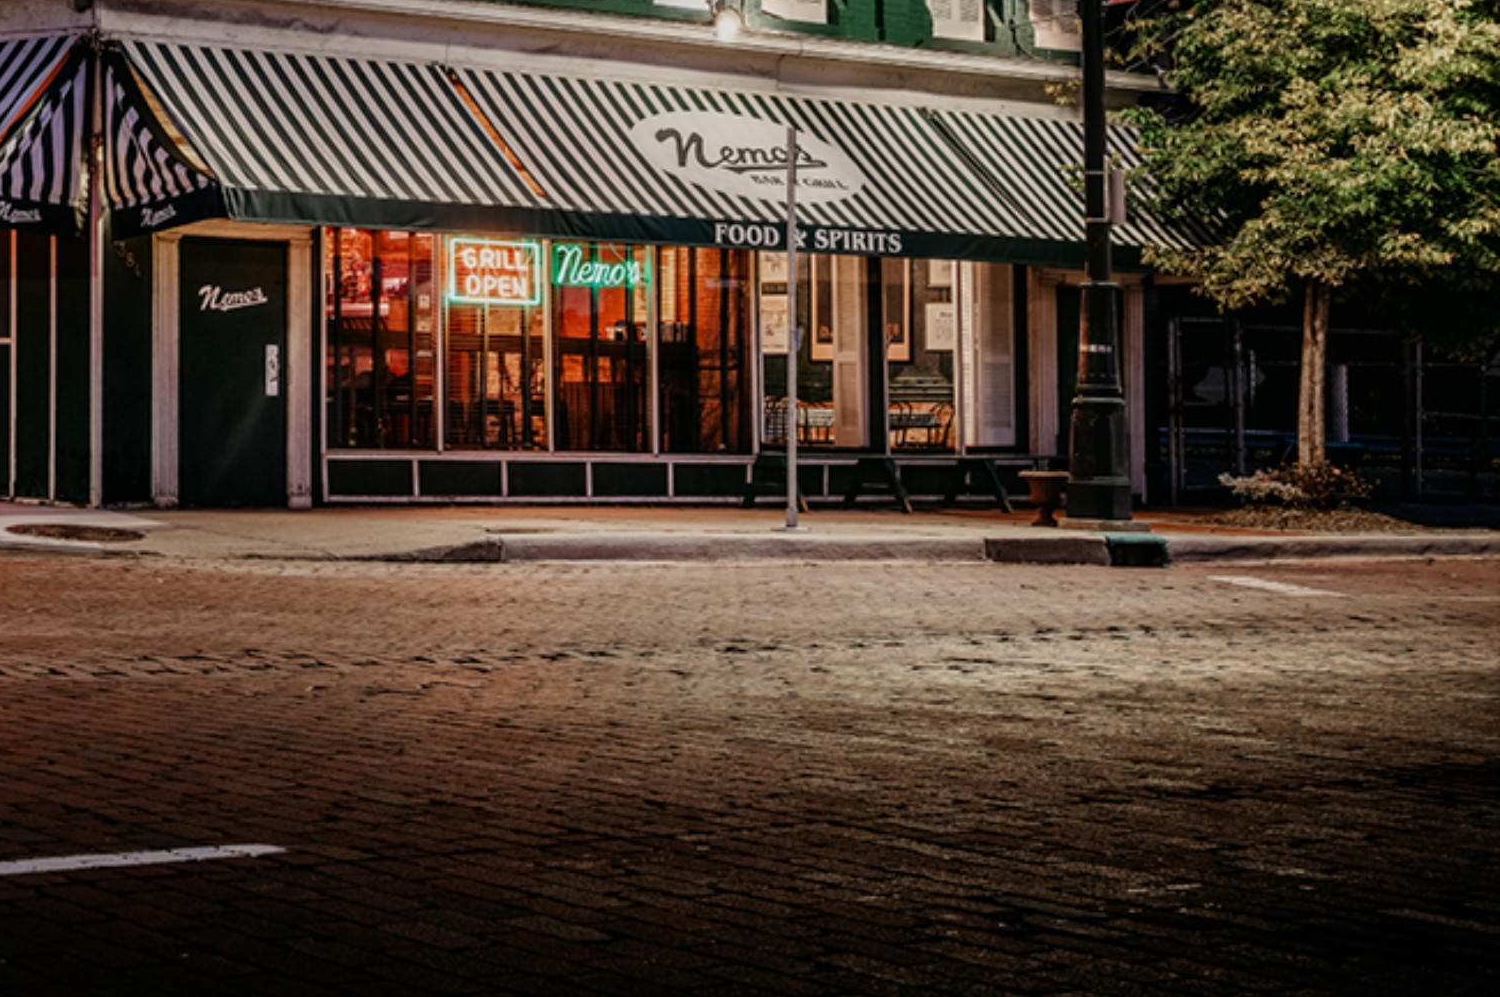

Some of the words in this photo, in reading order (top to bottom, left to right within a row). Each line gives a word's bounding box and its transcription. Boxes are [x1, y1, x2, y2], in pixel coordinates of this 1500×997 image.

[655, 128, 828, 174] Nemos
[750, 173, 786, 187] BAR
[802, 176, 850, 191] GRILL
[714, 223, 781, 247] FOOD
[813, 228, 904, 254] SPIRITS
[461, 246, 529, 272] GRILL
[555, 244, 643, 286] Nemo's
[465, 274, 528, 298] OPEN
